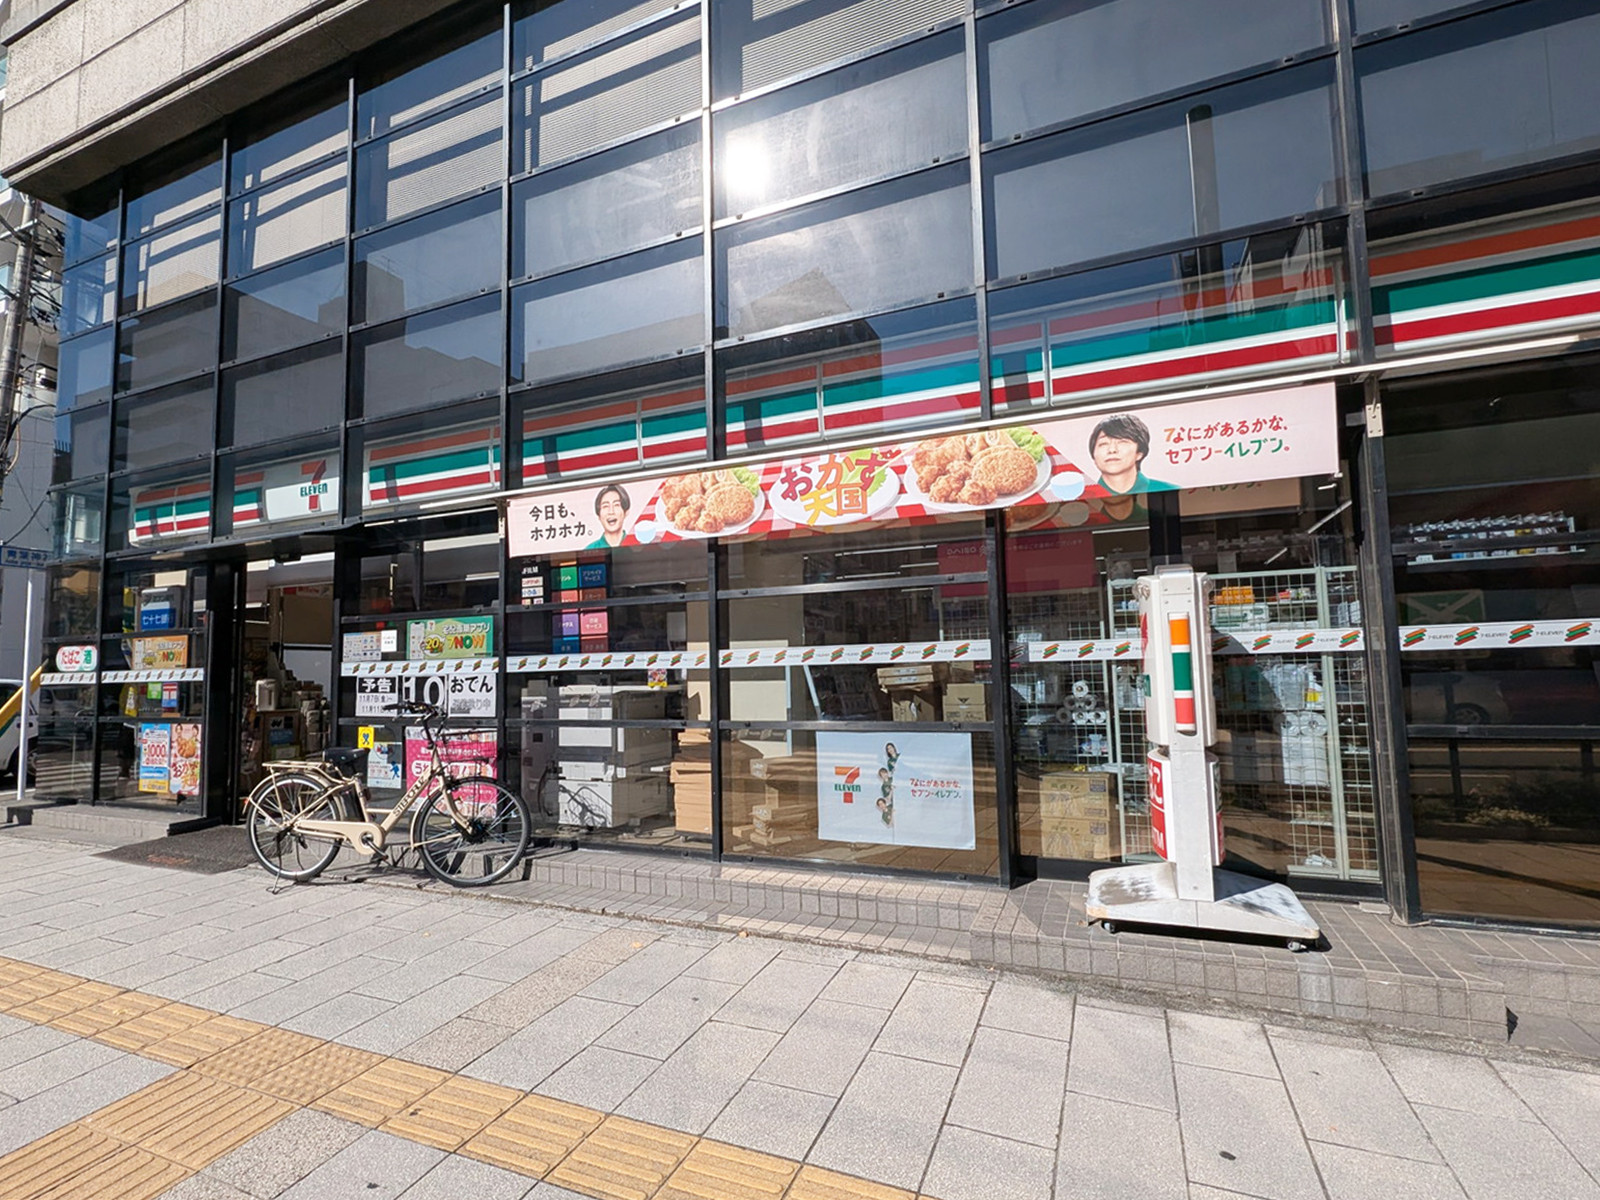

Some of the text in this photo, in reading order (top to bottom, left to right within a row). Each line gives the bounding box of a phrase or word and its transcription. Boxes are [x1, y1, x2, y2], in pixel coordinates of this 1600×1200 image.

[780, 450, 902, 502] おかず
[529, 502, 576, 522] 今日も、
[800, 482, 868, 527] 天国
[530, 521, 593, 541] ホカホカ。
[362, 678, 392, 692] 予告
[450, 676, 493, 693] おでん
